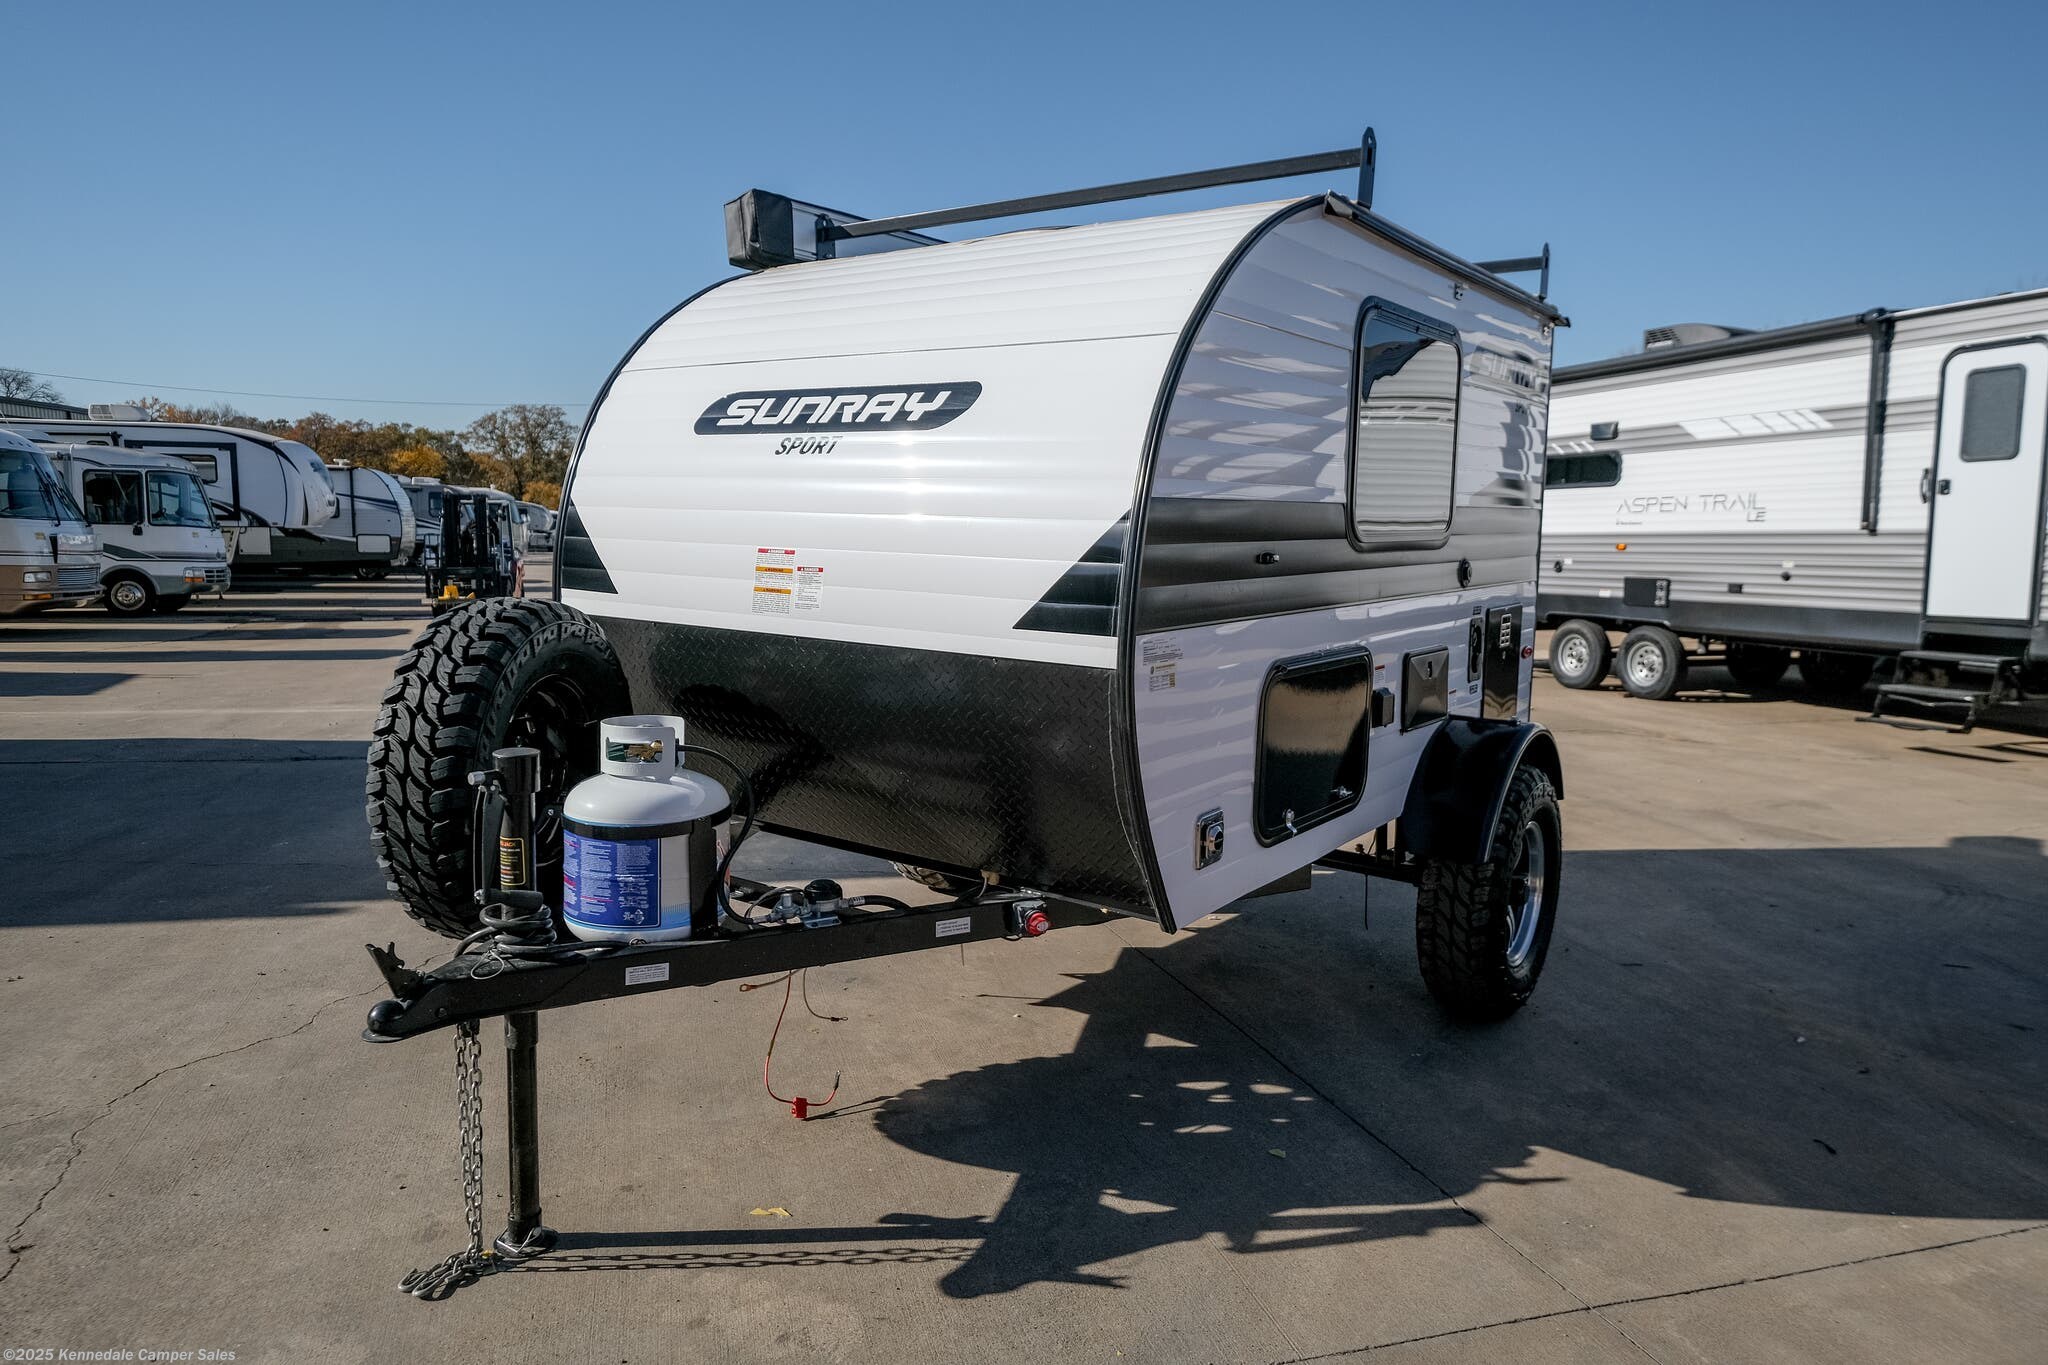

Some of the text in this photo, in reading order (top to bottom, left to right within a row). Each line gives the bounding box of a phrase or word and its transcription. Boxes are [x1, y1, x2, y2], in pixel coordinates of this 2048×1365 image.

[716, 391, 952, 426] SUNRAY
[774, 435, 844, 456] SPORT
[1617, 492, 1766, 512] ASPEN TRAIL
[1746, 511, 1766, 522] LE
